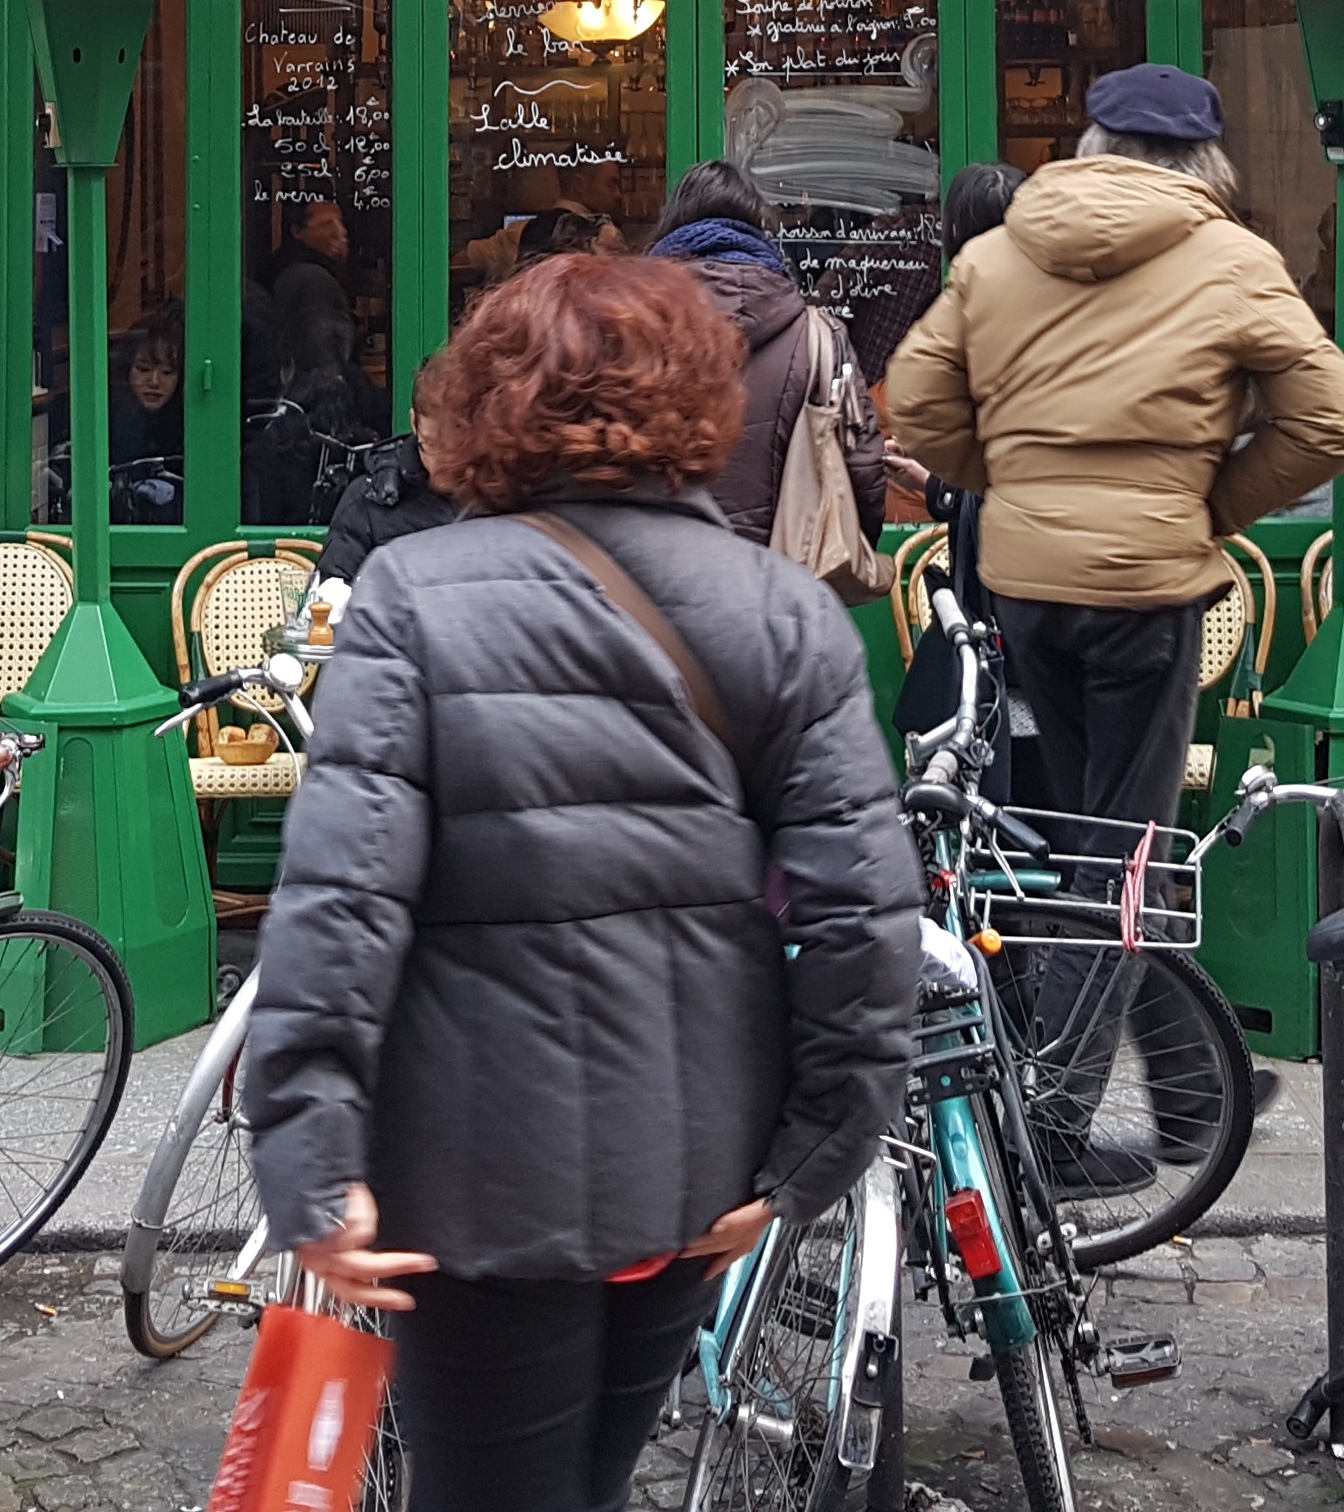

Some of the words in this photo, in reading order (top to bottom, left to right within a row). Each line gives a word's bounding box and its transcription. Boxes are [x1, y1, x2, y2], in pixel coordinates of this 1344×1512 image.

[245, 21, 318, 45] Chateau
[333, 25, 356, 45] de
[505, 27, 529, 58] le
[542, 27, 592, 60] bar
[273, 51, 356, 74] Varrains
[781, 45, 827, 84] plat
[834, 53, 860, 69] du
[287, 76, 339, 92] 2012
[799, 248, 820, 270] de
[824, 255, 929, 284] maquereau
